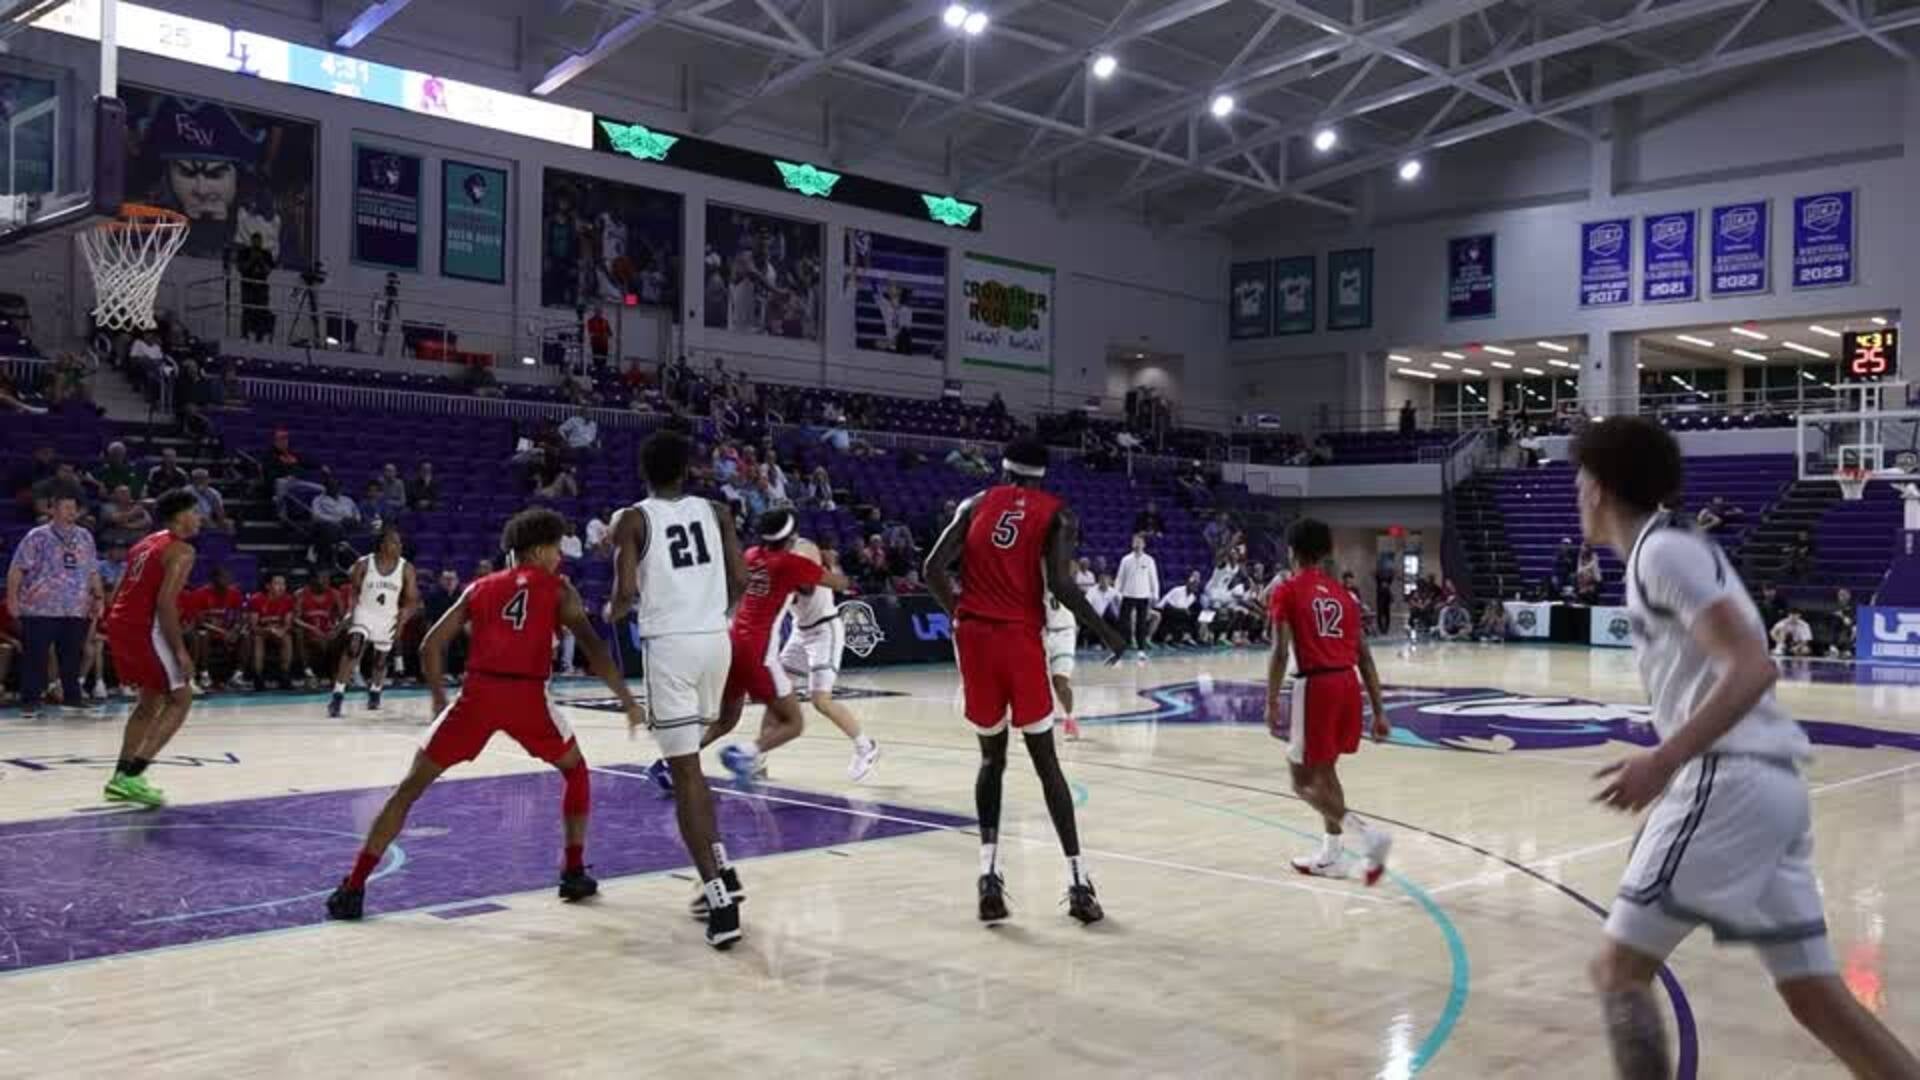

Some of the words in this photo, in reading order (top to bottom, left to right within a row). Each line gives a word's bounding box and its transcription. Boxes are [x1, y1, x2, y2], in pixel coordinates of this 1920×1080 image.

[175, 112, 214, 146] FSW
[1716, 272, 1760, 289] 2022
[1800, 264, 1844, 282] 2023
[1587, 290, 1622, 304] 2017
[1649, 281, 1687, 297] 2021
[1852, 347, 1885, 373] 25
[992, 509, 1026, 549] 5
[666, 521, 711, 569] 21
[376, 593, 386, 606] 4
[502, 589, 529, 630] 4
[1312, 597, 1344, 638] 12
